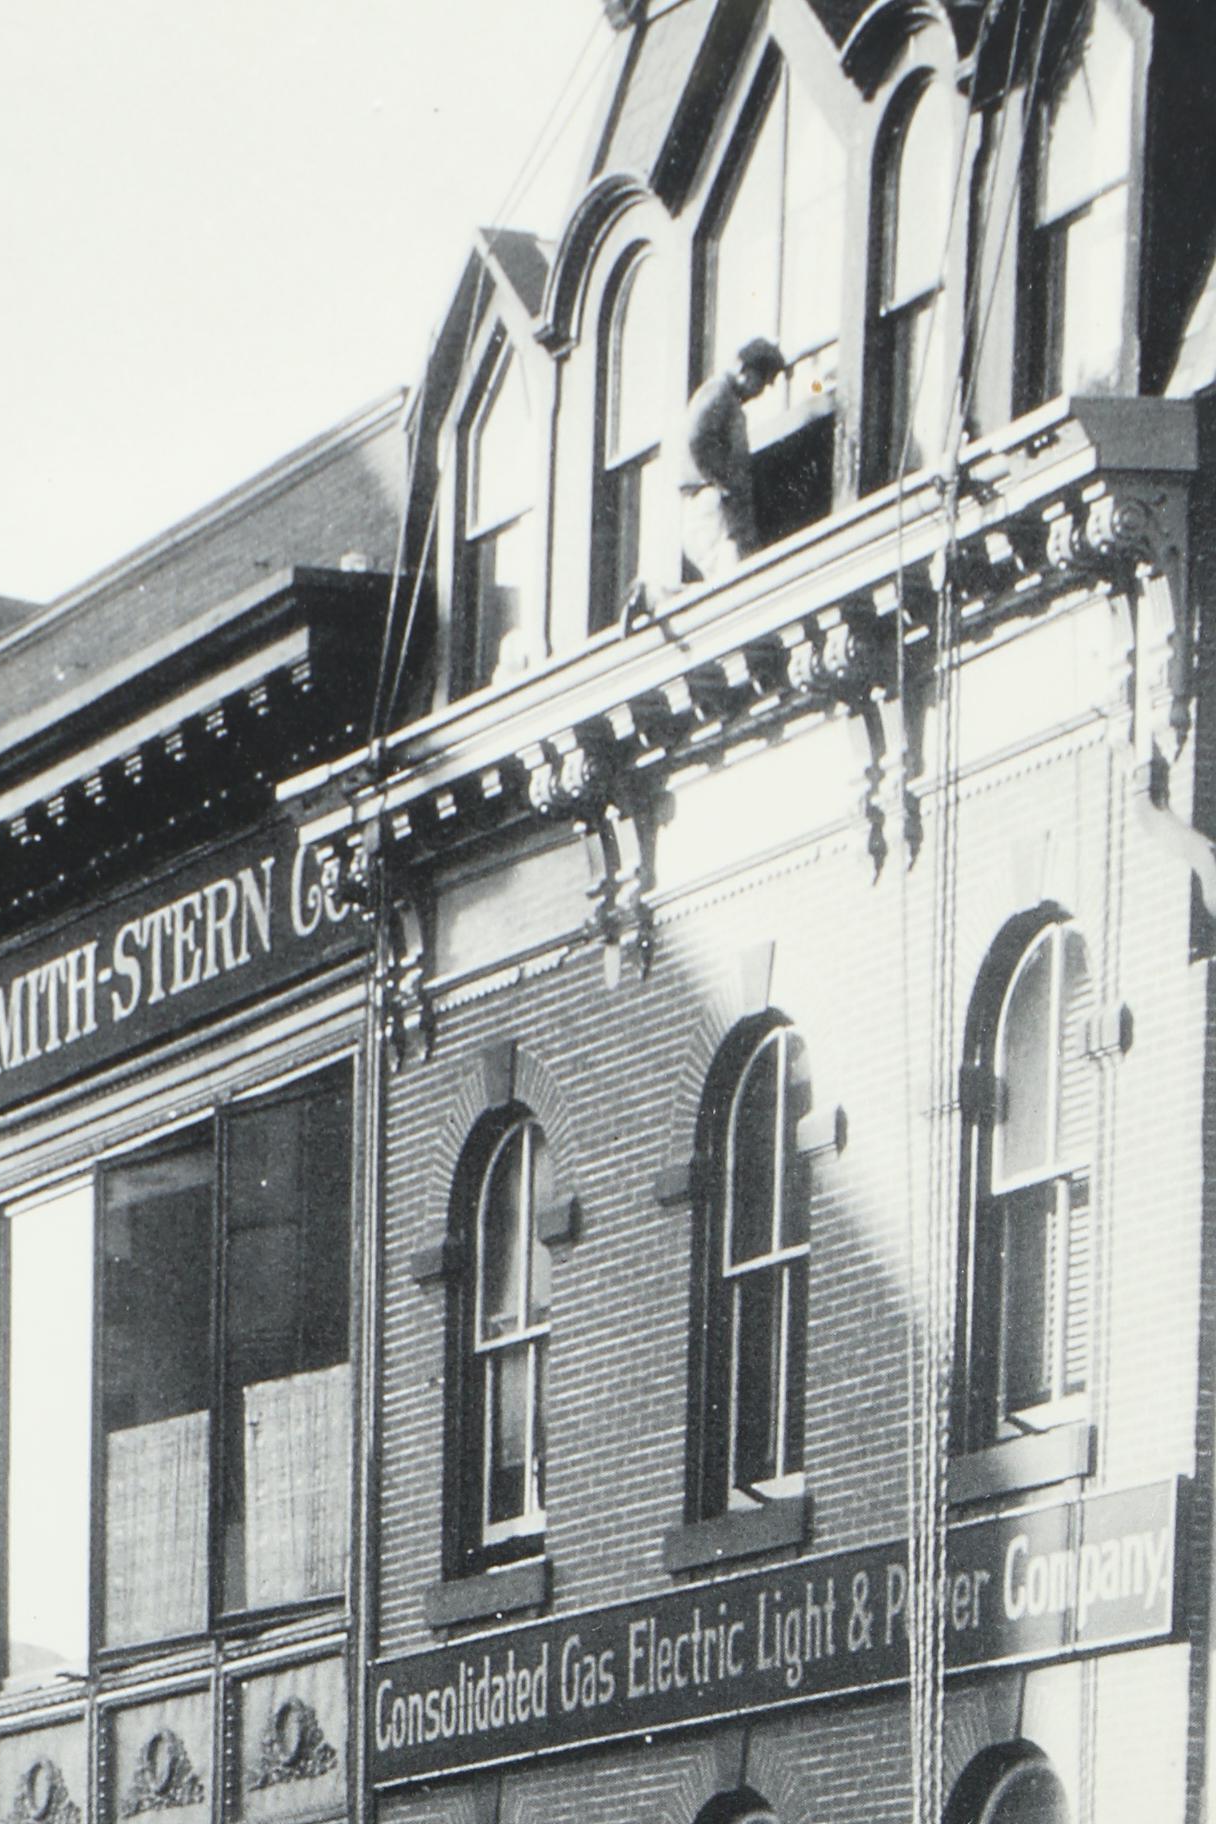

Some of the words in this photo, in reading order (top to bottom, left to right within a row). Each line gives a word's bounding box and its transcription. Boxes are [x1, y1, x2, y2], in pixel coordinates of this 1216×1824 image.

[375, 1645, 548, 1750] Consolidated
[561, 1633, 618, 1711] Gas
[627, 1602, 744, 1701] Electric
[758, 1582, 838, 1689] Light
[847, 1569, 875, 1649] &
[885, 1563, 990, 1645] Per
